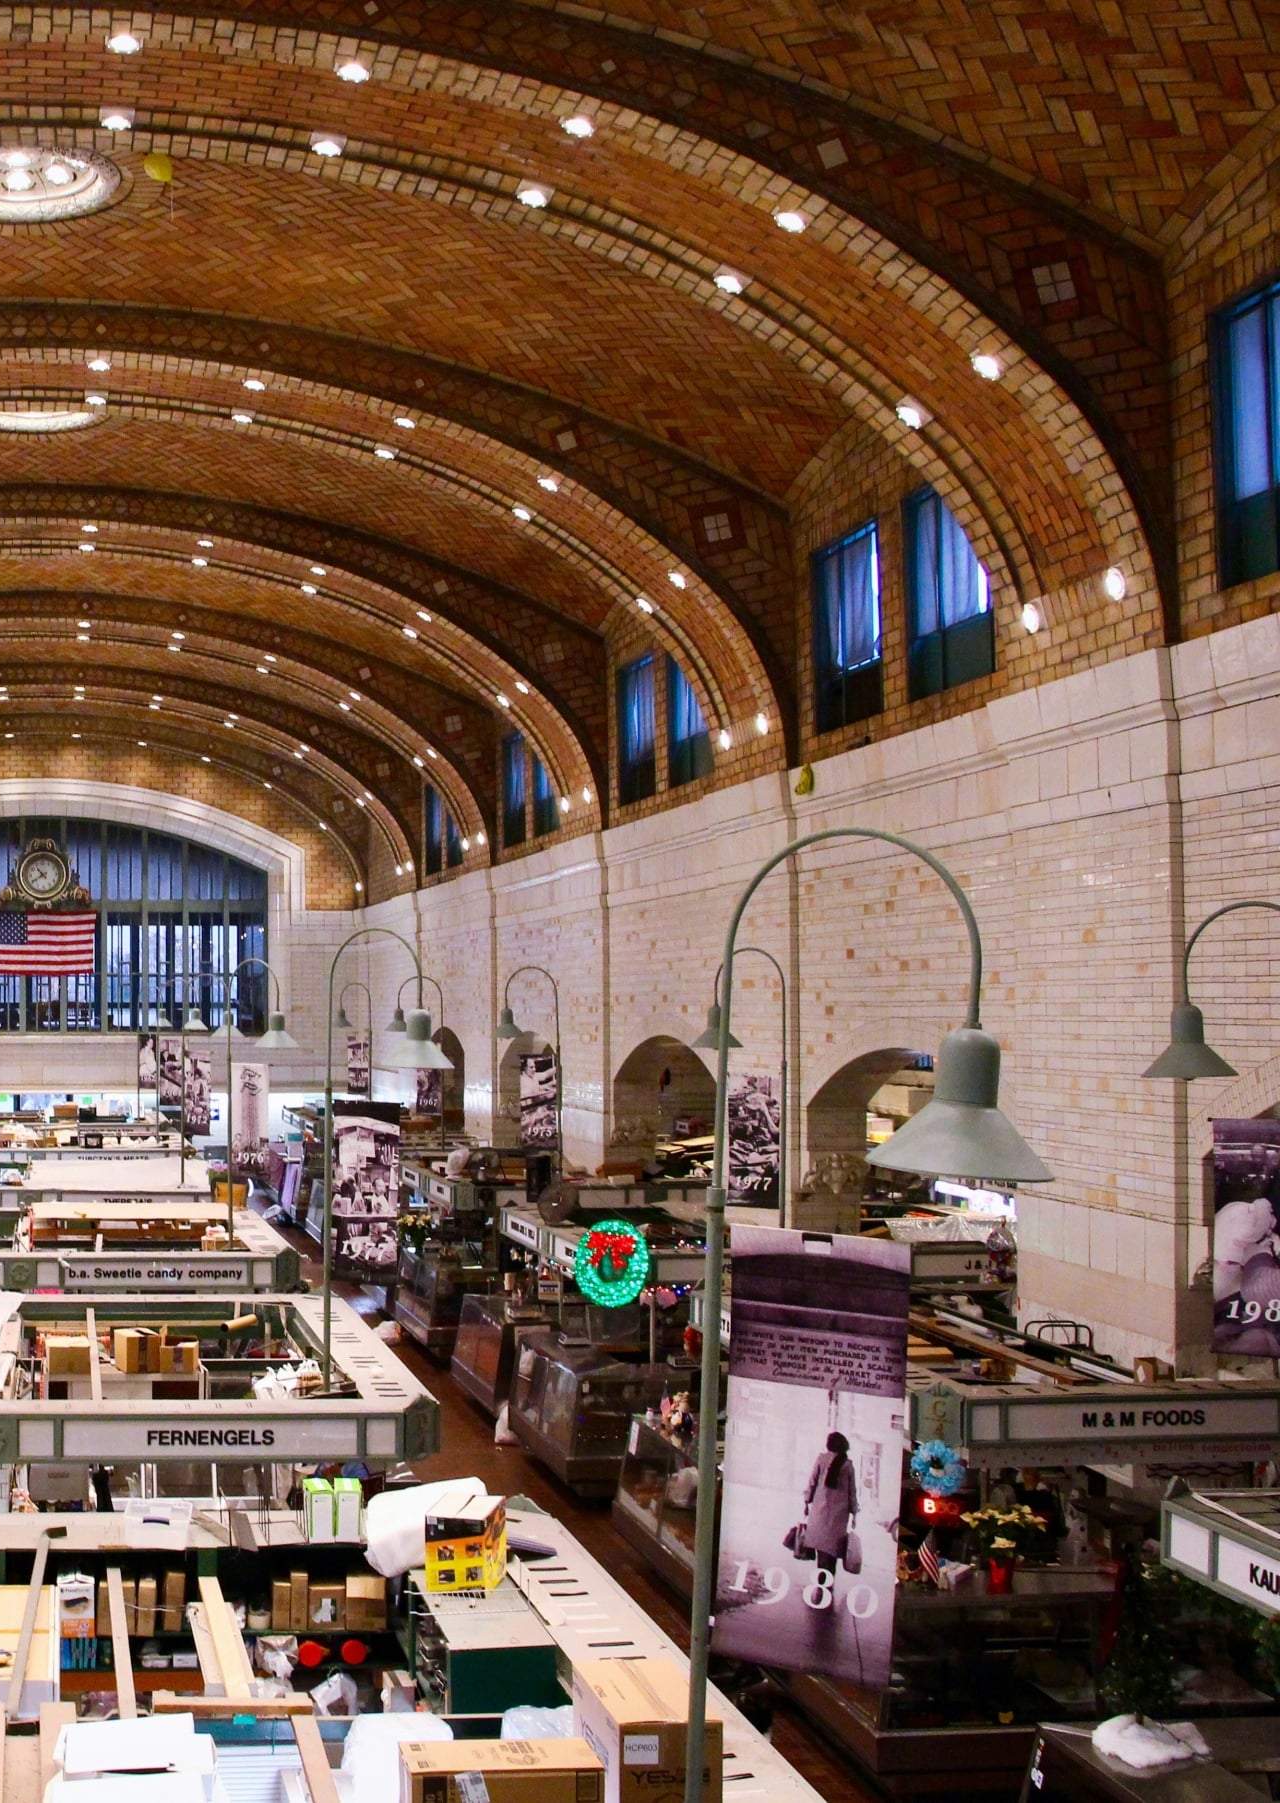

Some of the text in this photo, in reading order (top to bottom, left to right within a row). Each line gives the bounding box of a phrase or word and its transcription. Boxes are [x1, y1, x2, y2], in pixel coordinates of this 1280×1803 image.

[236, 1151, 264, 1165] 1976
[735, 1175, 773, 1192] 1977
[69, 1267, 90, 1279] b.a.
[147, 1267, 183, 1281] candy
[189, 1270, 243, 1281] company
[1227, 1299, 1280, 1324] 198
[824, 1349, 867, 1360] PURCHASED
[847, 1343, 880, 1353] RECHECK
[749, 1357, 767, 1365] THAT
[773, 1360, 806, 1371] PURPOSE
[839, 1368, 870, 1378] MARKET
[812, 1356, 854, 1367] INSTALLED
[867, 1363, 893, 1373] SCALE
[933, 1400, 946, 1418] C
[1082, 1410, 1206, 1427] M & M FOODS
[147, 1430, 275, 1446] FERNENGELS
[1249, 1563, 1280, 1597] KAU
[728, 1559, 879, 1619] 1980
